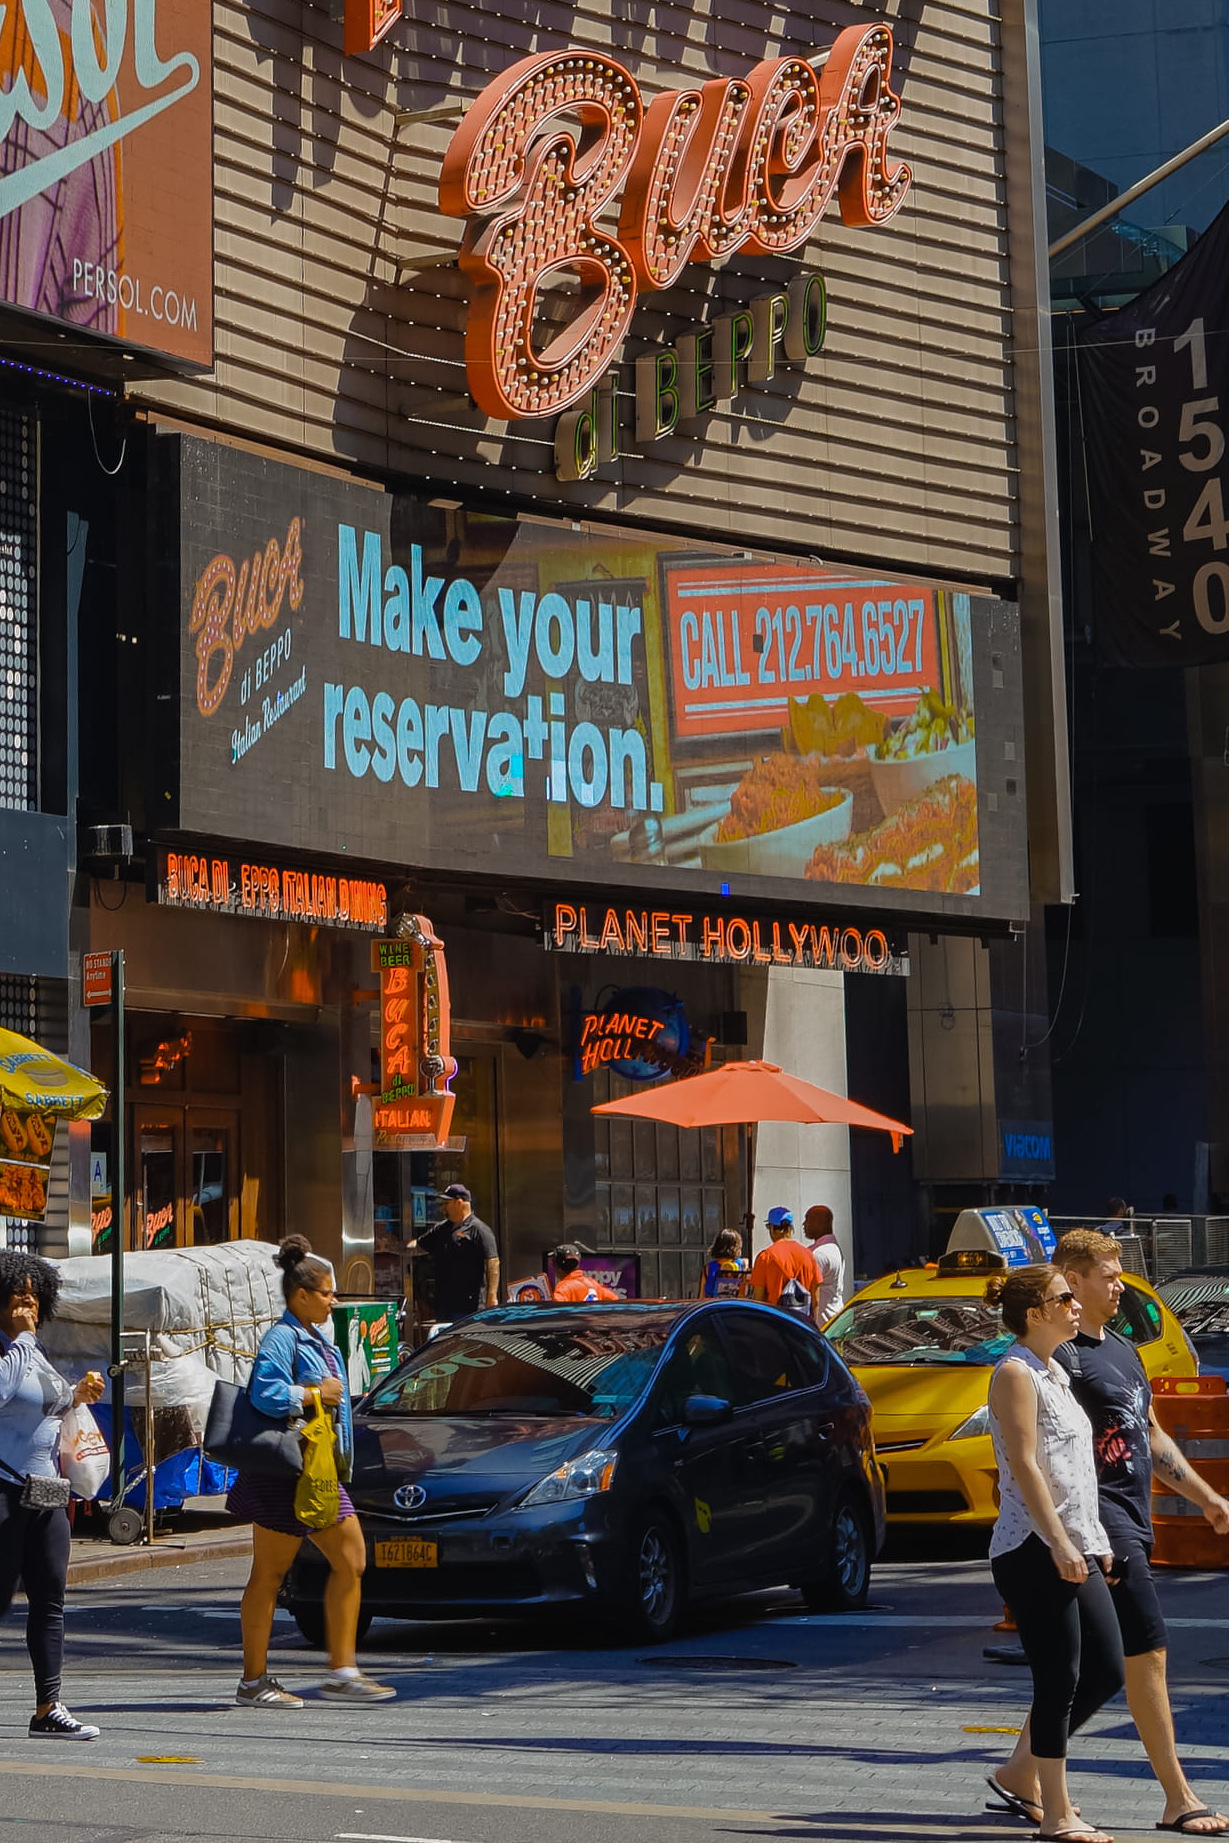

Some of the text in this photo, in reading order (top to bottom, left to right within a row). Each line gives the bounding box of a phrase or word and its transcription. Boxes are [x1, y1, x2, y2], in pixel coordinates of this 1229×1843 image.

[71, 256, 198, 332] PERSOL.COM
[635, 271, 827, 443] BEPPO
[1134, 327, 1183, 641] BROADWAY
[1173, 317, 1229, 636] 1540
[337, 521, 642, 700] Make your
[679, 596, 927, 692] CALL 212.764.6527
[240, 627, 292, 706] di BEPPO
[231, 664, 307, 765] Italian Restaurant
[322, 682, 664, 814] reservation.
[167, 853, 210, 902] BUCA
[211, 859, 229, 905] DI
[282, 870, 337, 920] ITALIAN
[378, 942, 411, 956] WINE
[379, 955, 412, 968] BEER
[554, 903, 901, 971] PLANET HOLLYWOO
[384, 966, 411, 1075] BUCA
[580, 1011, 666, 1047] PLANET
[24, 1092, 84, 1108] SABRETT
[375, 1109, 431, 1129] ITALIAN
[381, 1083, 414, 1105] BEPPO
[93, 1160, 103, 1181] A
